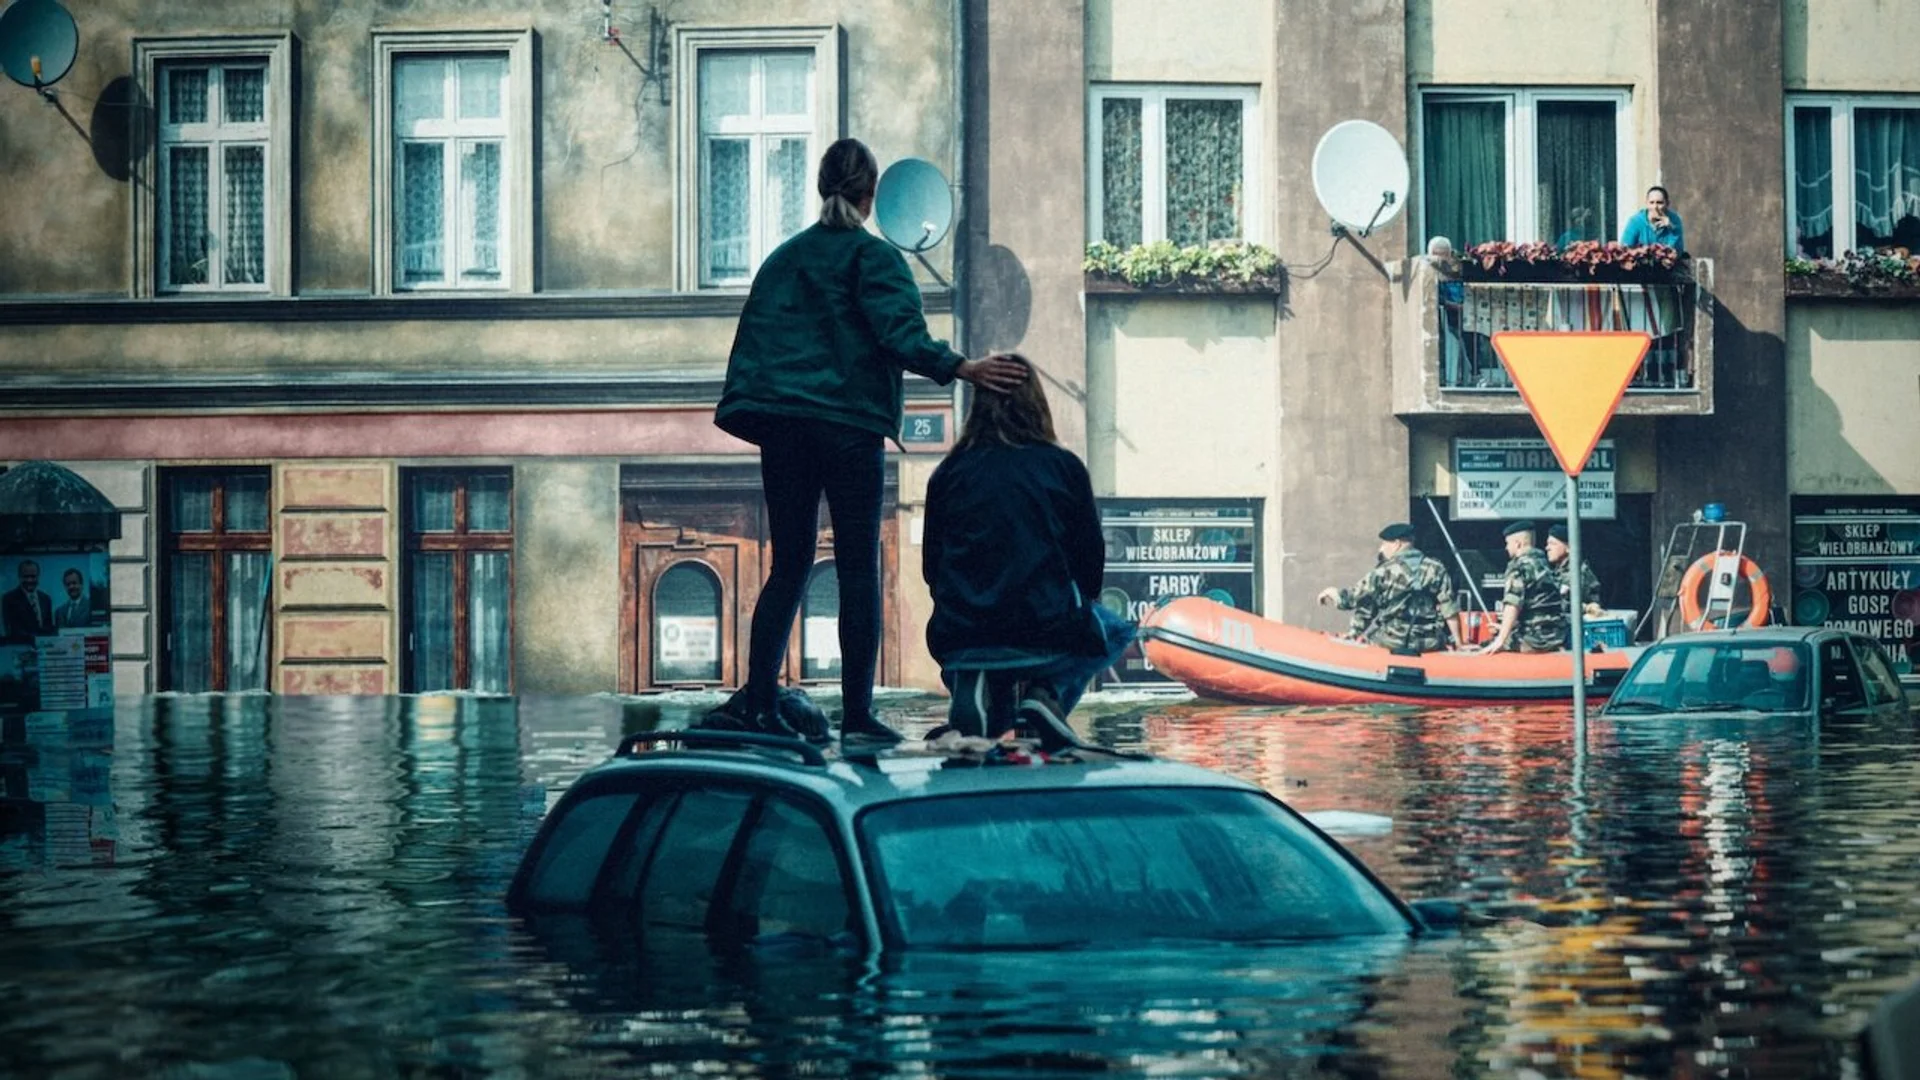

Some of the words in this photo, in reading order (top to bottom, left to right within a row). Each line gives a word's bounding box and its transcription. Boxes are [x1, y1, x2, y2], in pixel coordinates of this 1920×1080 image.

[914, 418, 931, 435] 25
[1506, 450, 1611, 468] MAXAL
[1153, 528, 1191, 543] SKLEP
[1844, 524, 1880, 538] SKLEP
[1126, 544, 1228, 561] WIELOBRANŻOWY
[1819, 539, 1914, 555] WIELOBRANŻOWY
[1150, 574, 1200, 596] FARBY
[1826, 570, 1911, 591] ARTYKUŁY
[1848, 595, 1890, 615] GOSP.
